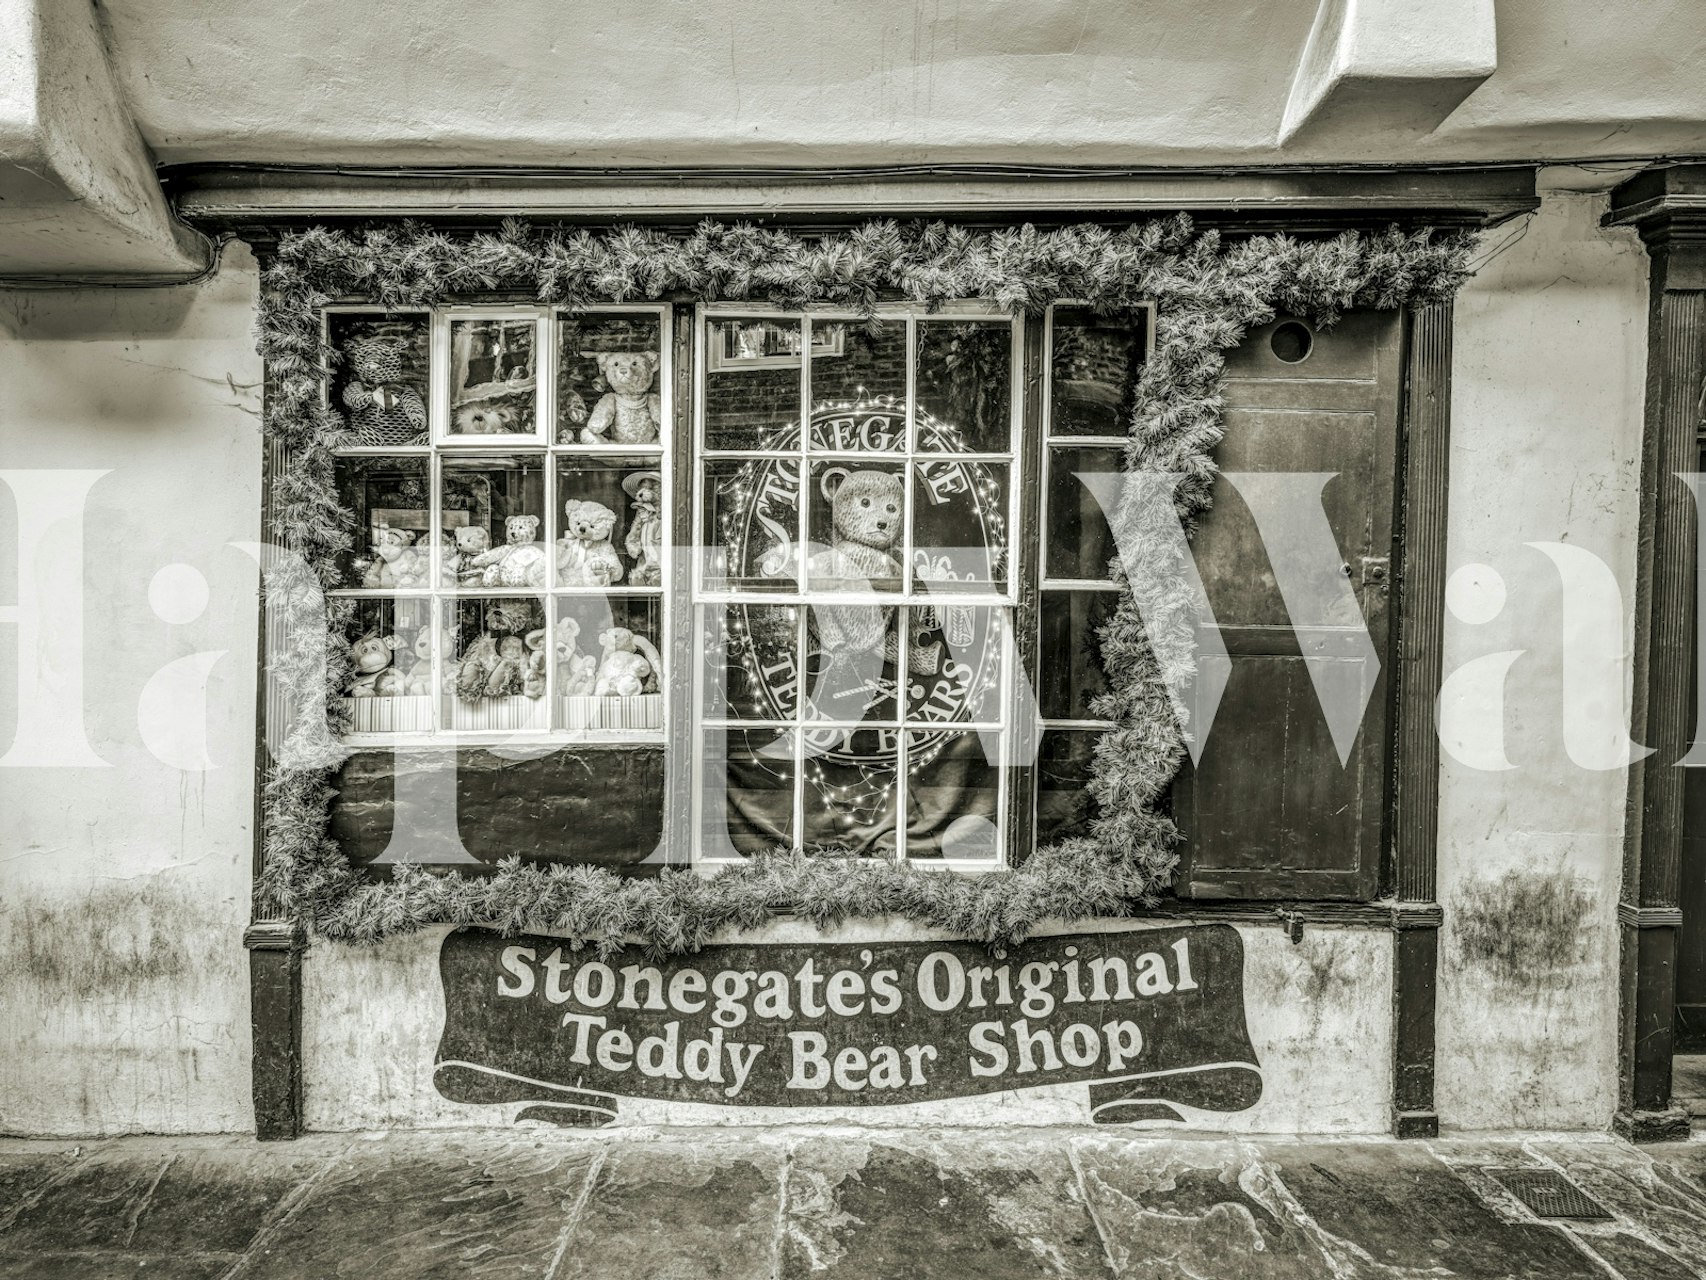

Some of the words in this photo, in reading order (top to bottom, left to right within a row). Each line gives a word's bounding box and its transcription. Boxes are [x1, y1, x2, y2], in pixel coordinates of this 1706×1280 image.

[761, 651, 860, 754] TEDDY
[875, 658, 973, 753] BEARS
[497, 944, 902, 1029] Stonegate's
[917, 937, 1199, 1019] Original
[562, 1011, 765, 1097] Teddy
[786, 1030, 938, 1091] Bear
[968, 1018, 1143, 1078] Shop
